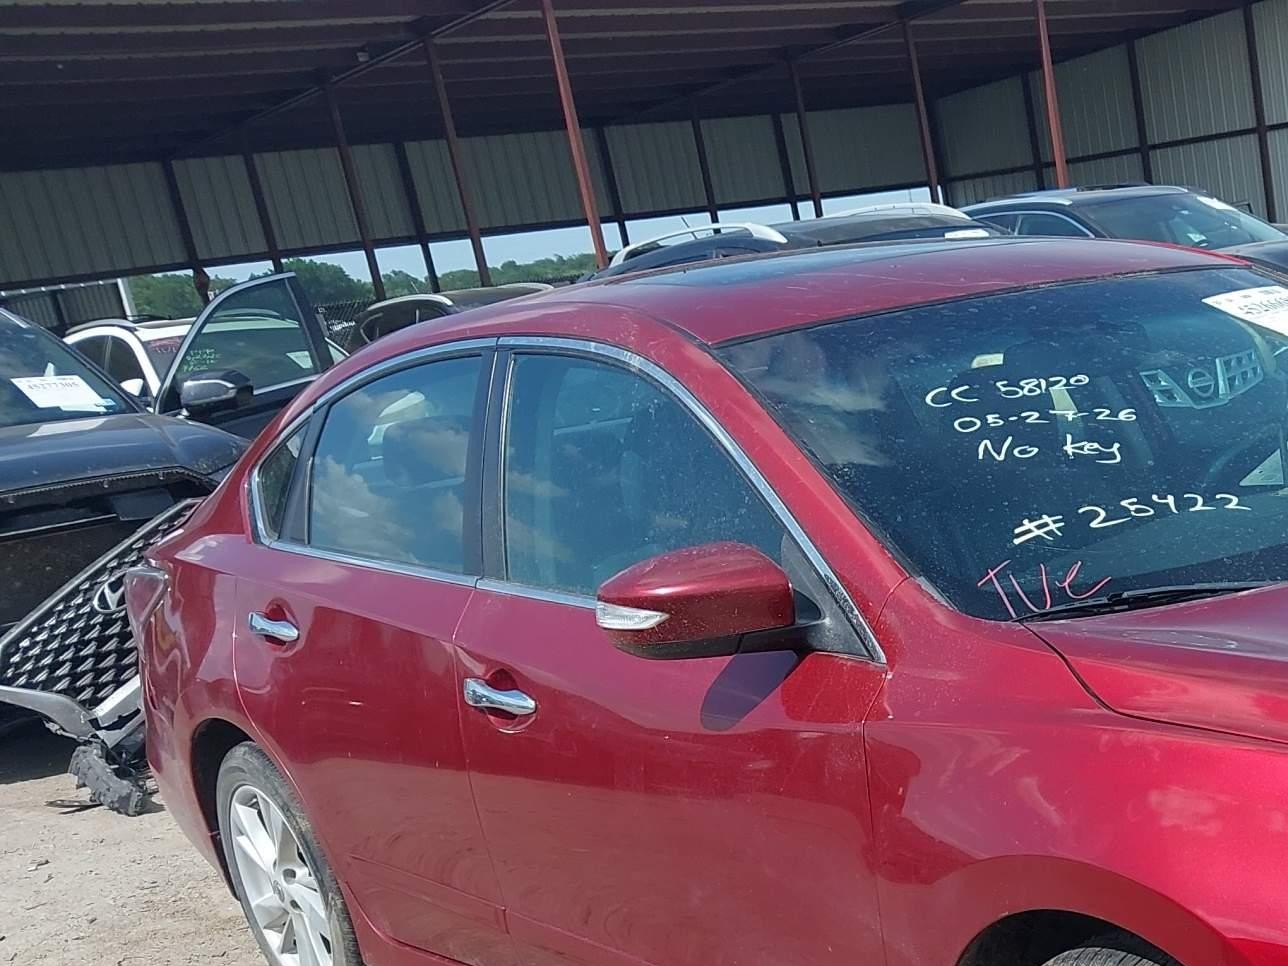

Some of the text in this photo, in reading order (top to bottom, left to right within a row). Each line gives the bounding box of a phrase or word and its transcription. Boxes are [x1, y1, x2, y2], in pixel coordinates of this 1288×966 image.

[925, 374, 1090, 408] CC 58120
[978, 435, 1040, 461] No
[1013, 493, 1252, 546] # 25422
